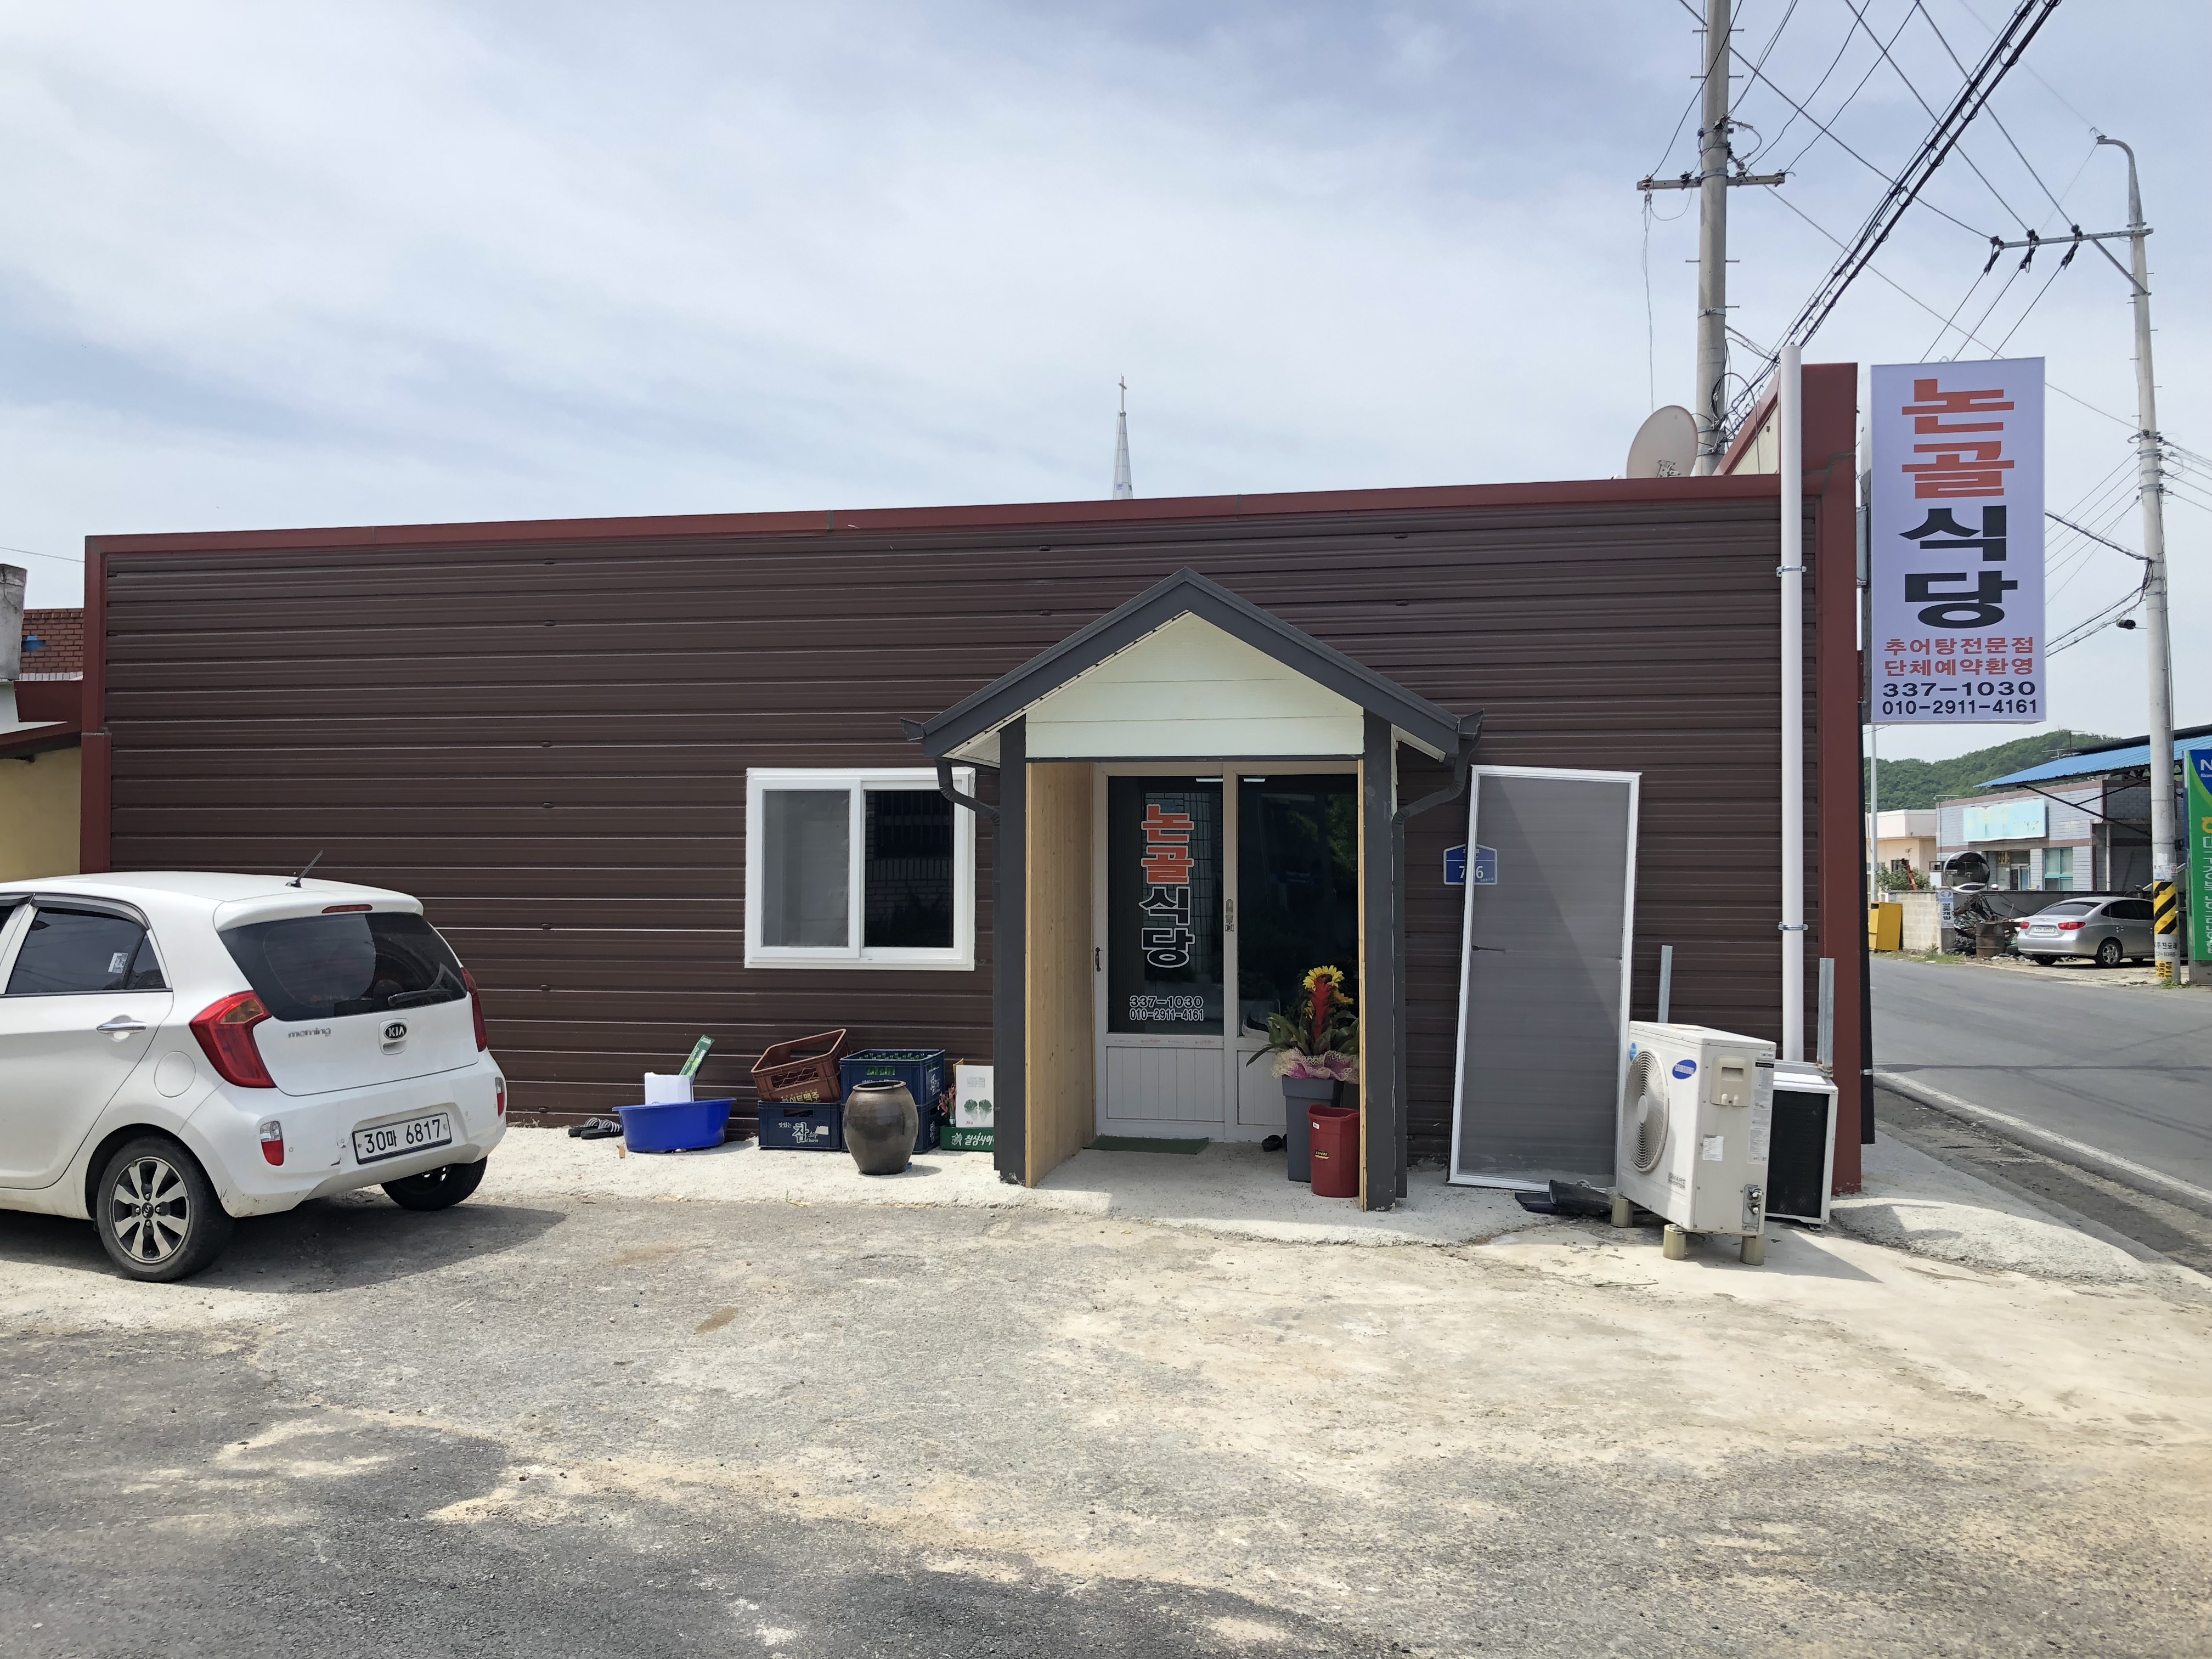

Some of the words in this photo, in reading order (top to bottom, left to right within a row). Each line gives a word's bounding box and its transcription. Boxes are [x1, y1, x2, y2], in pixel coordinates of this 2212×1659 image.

[1898, 379, 2018, 629] 논골식당
[1884, 636, 2034, 656] 추어탕전문점
[1884, 657, 2034, 677] 단체예약환영
[1883, 681, 2036, 697] 337-1030
[1882, 699, 2036, 715] 010-2911-4161
[1138, 804, 1195, 968] 논골식당
[1129, 995, 1204, 1008] 337-1030
[1129, 1008, 1204, 1022] 010-2911-4161
[388, 1026, 405, 1037] KIA
[1675, 1064, 1694, 1075] SAMSUNG
[364, 1131, 397, 1154] 30마
[405, 1119, 441, 1144] 6817
[792, 1122, 810, 1143] 참
[964, 1132, 994, 1146] 칠성사이
